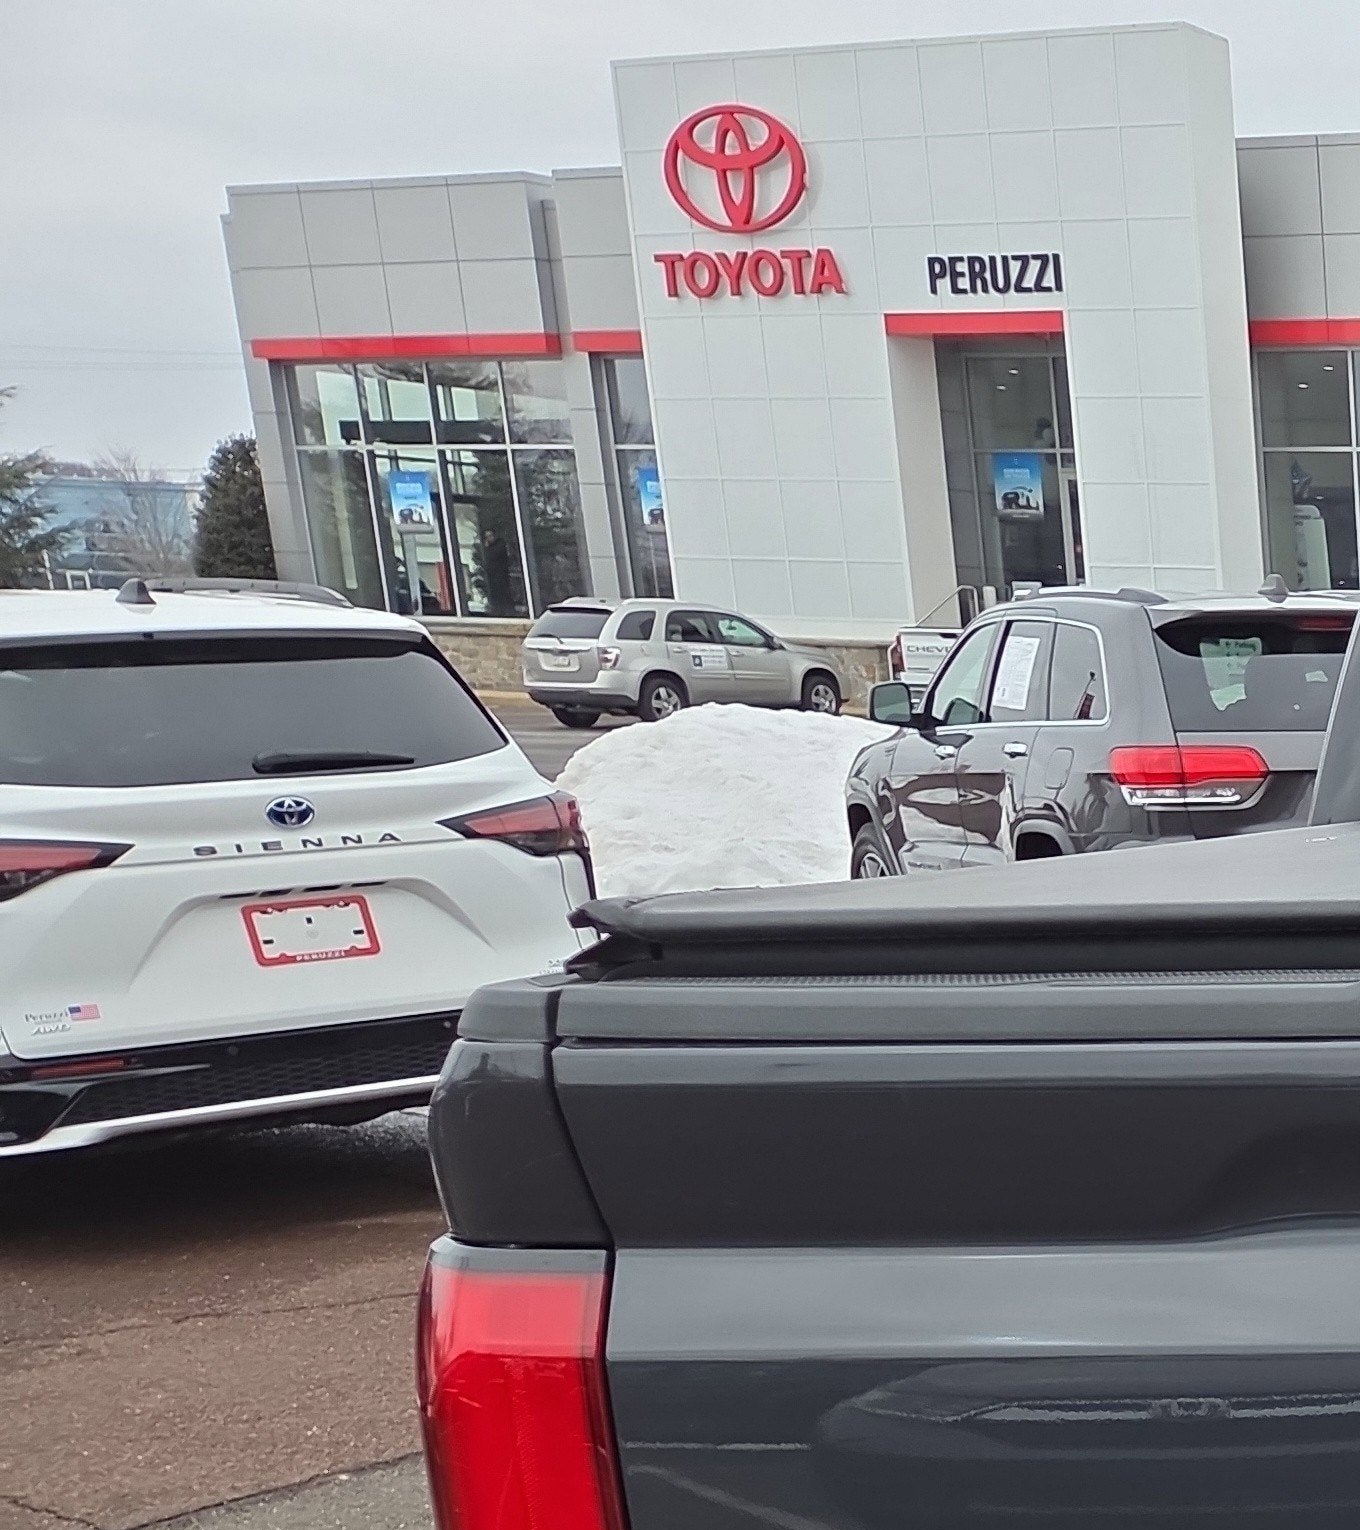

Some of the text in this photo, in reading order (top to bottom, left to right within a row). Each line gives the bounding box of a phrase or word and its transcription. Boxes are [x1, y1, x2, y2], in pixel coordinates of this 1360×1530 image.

[653, 248, 846, 297] TOYOTA
[926, 252, 1064, 296] PERUZZI
[193, 832, 402, 857] SIENNA
